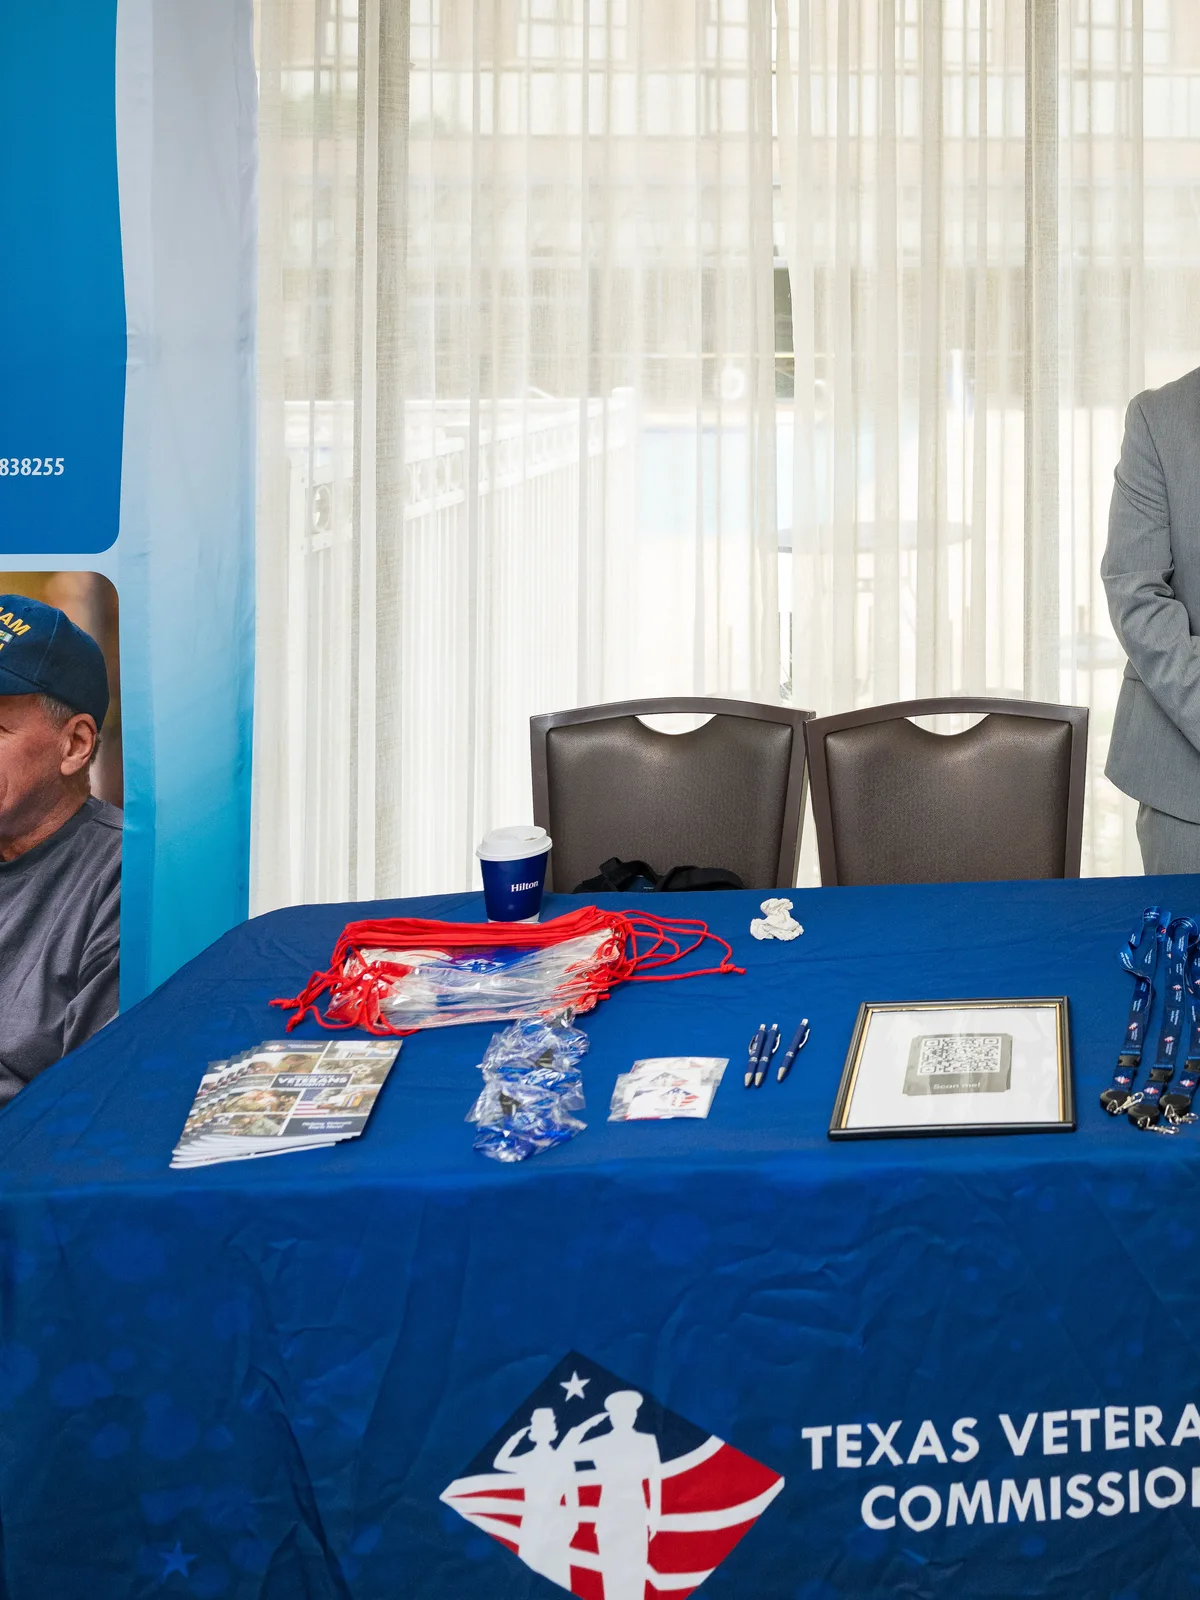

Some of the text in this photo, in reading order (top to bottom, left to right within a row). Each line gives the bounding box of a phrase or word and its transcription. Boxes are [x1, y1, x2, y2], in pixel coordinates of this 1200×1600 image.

[0, 457, 64, 476] 838255
[511, 880, 539, 893] Hilton
[278, 1076, 348, 1084] VETERANS
[802, 1418, 979, 1470] TEXAS
